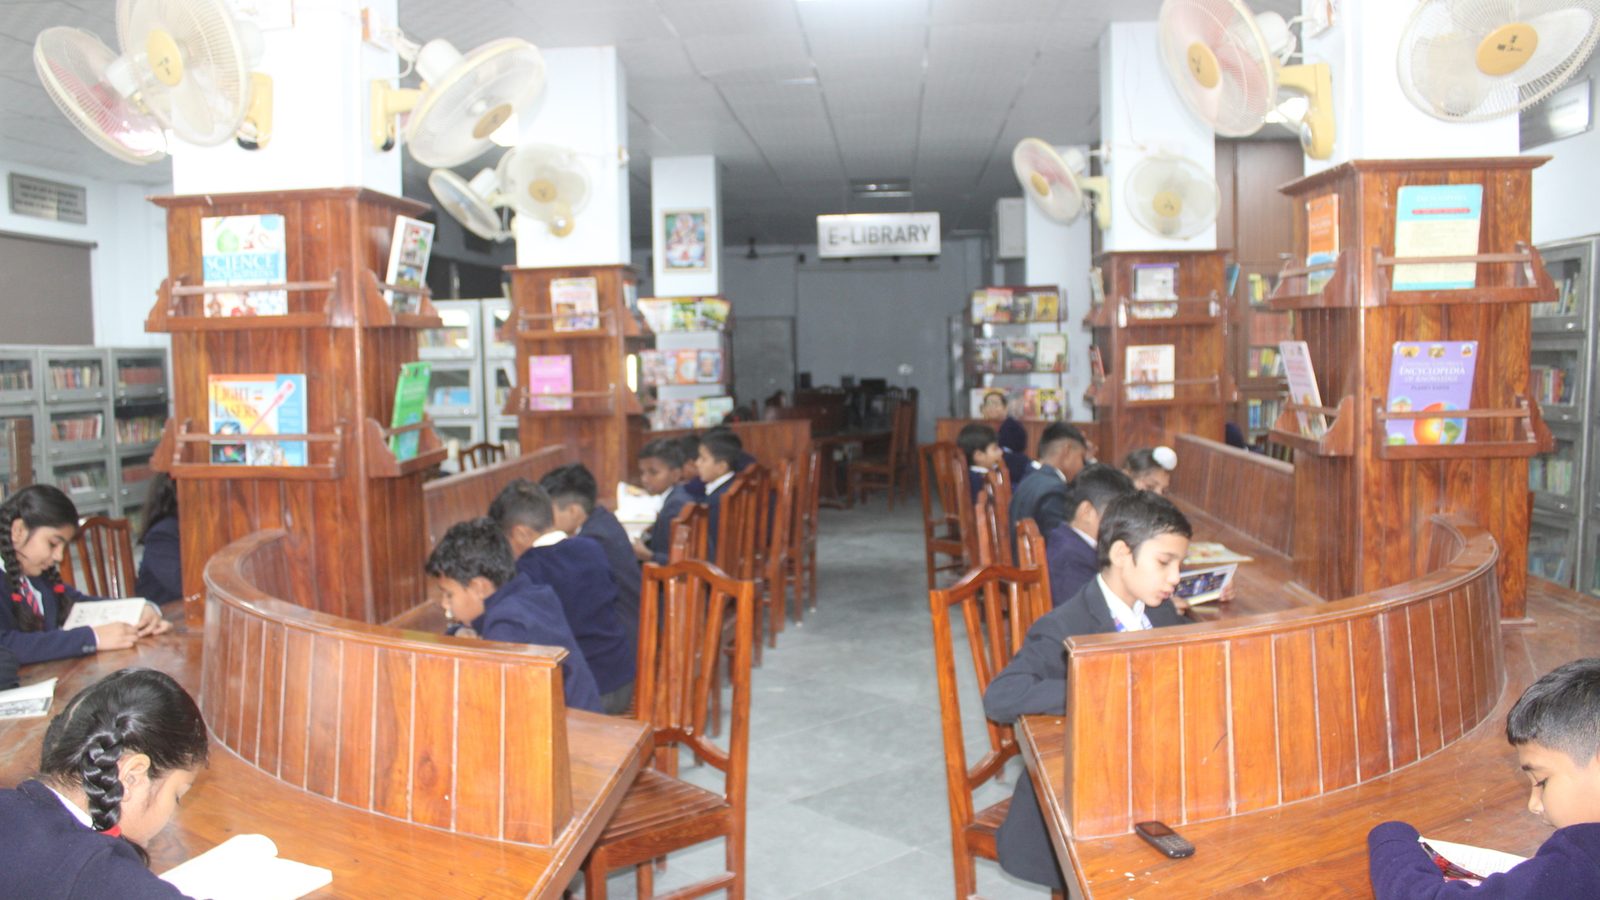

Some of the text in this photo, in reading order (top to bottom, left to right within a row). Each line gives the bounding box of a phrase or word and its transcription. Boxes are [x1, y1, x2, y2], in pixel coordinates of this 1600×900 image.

[828, 224, 931, 246] E-LIBRARY
[206, 254, 273, 272] SCIENCE
[1399, 366, 1466, 376] ENCYCLOPEDIA
[214, 384, 250, 402] LIGHT
